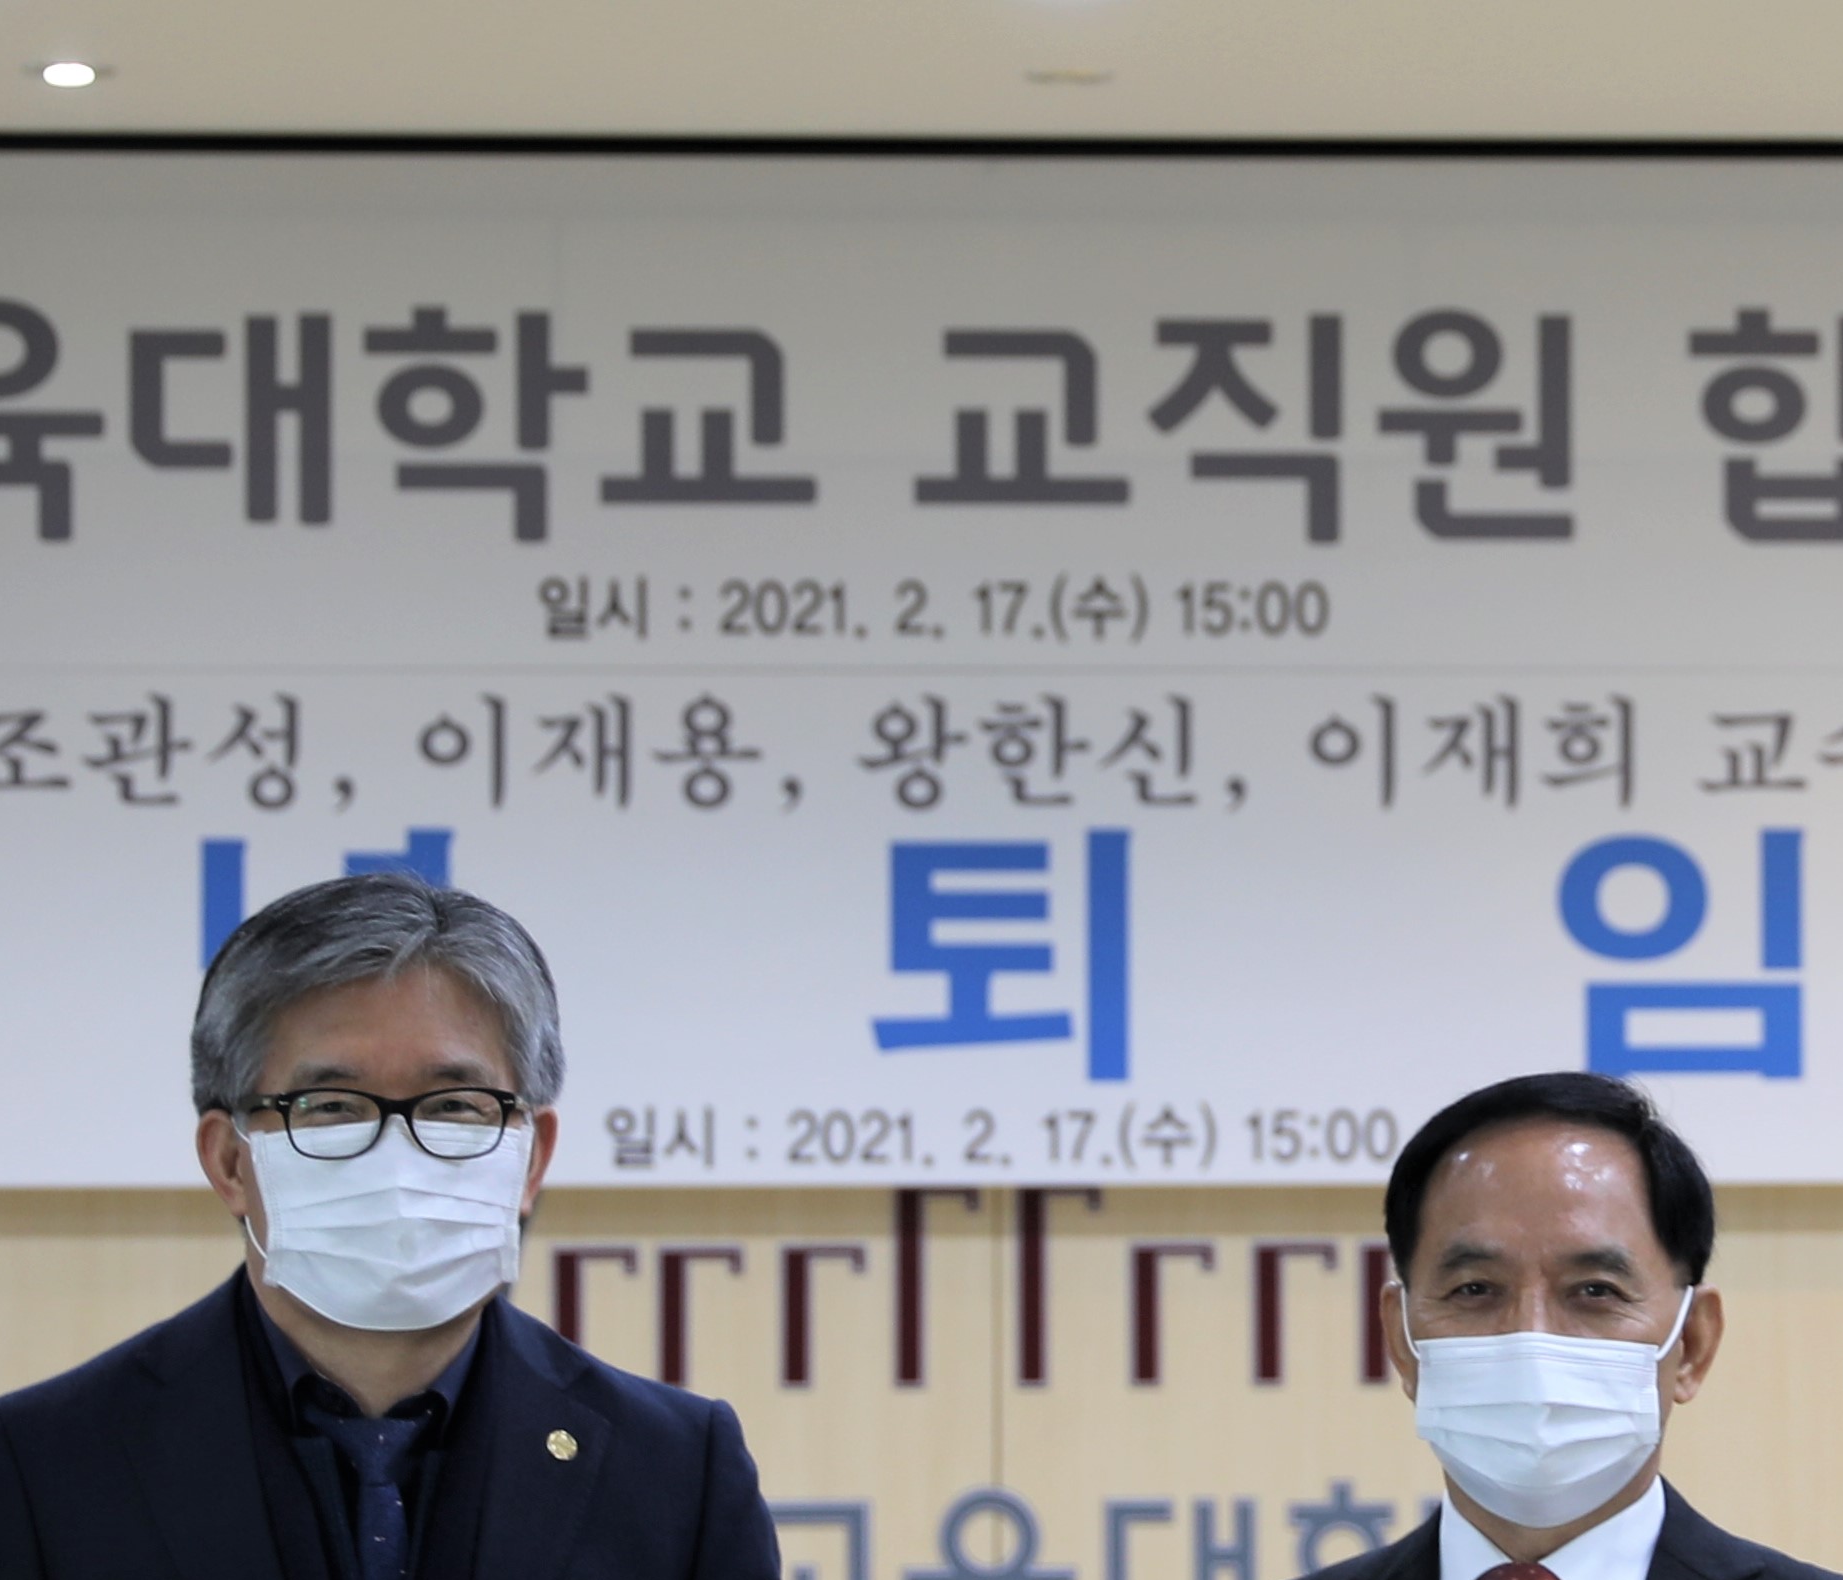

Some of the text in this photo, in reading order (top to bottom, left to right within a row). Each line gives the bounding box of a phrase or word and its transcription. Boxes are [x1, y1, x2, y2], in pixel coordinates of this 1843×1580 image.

[914, 307, 1574, 545] 교직원
[538, 576, 648, 640] 일시
[719, 578, 867, 638] 2021.
[894, 578, 944, 639] 2.
[973, 572, 1151, 642] 17.(수)
[1176, 580, 1330, 637] 15:00
[418, 694, 802, 810] 이재용,
[860, 694, 1246, 811] 왕한신,
[1308, 694, 1634, 807] 이재희
[605, 1108, 714, 1169] 일시
[787, 1108, 934, 1167] 2021.
[963, 1108, 1011, 1167] 2.
[1042, 1101, 1218, 1169] 17.(수)
[1246, 1107, 1397, 1165] 15:00
